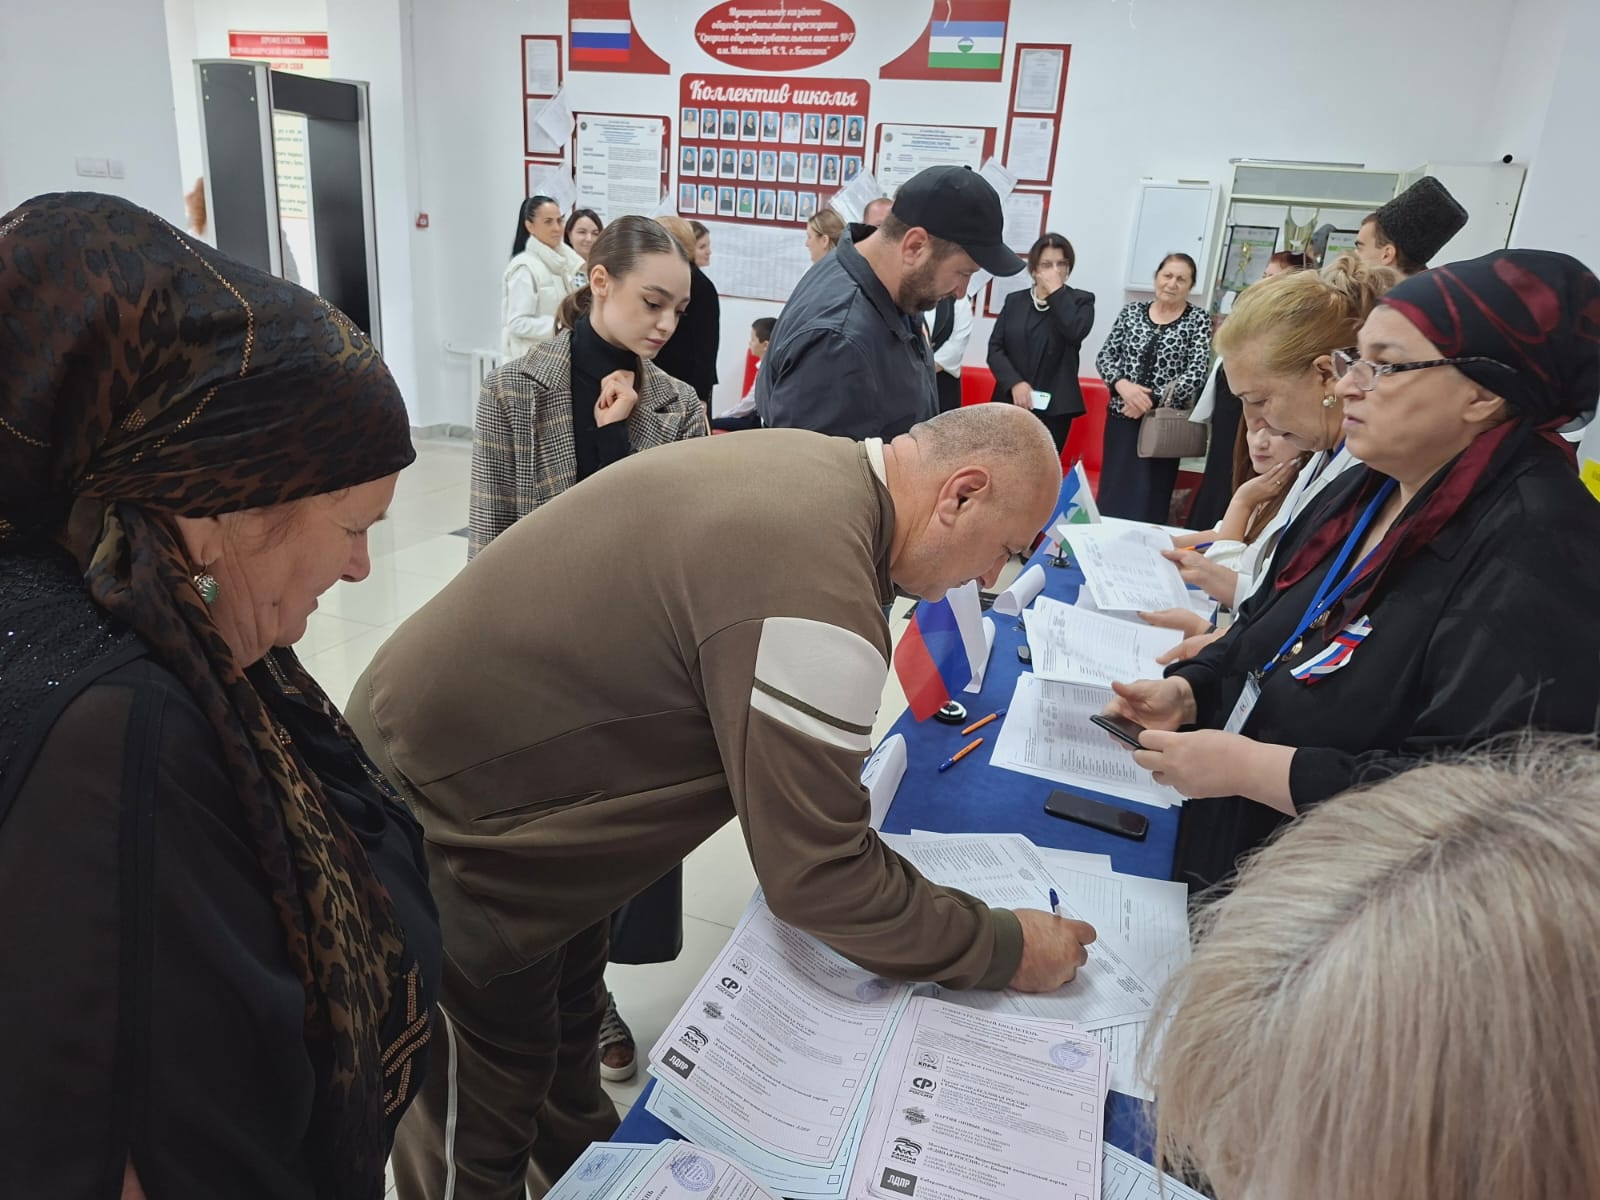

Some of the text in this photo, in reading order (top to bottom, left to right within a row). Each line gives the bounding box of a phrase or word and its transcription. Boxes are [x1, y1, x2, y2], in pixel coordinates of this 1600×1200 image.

[689, 80, 857, 106] Коллектив школы
[668, 1055, 689, 1072] ЛДПР
[918, 1061, 937, 1069] КПРФ
[887, 1174, 911, 1189] ЛДПР
